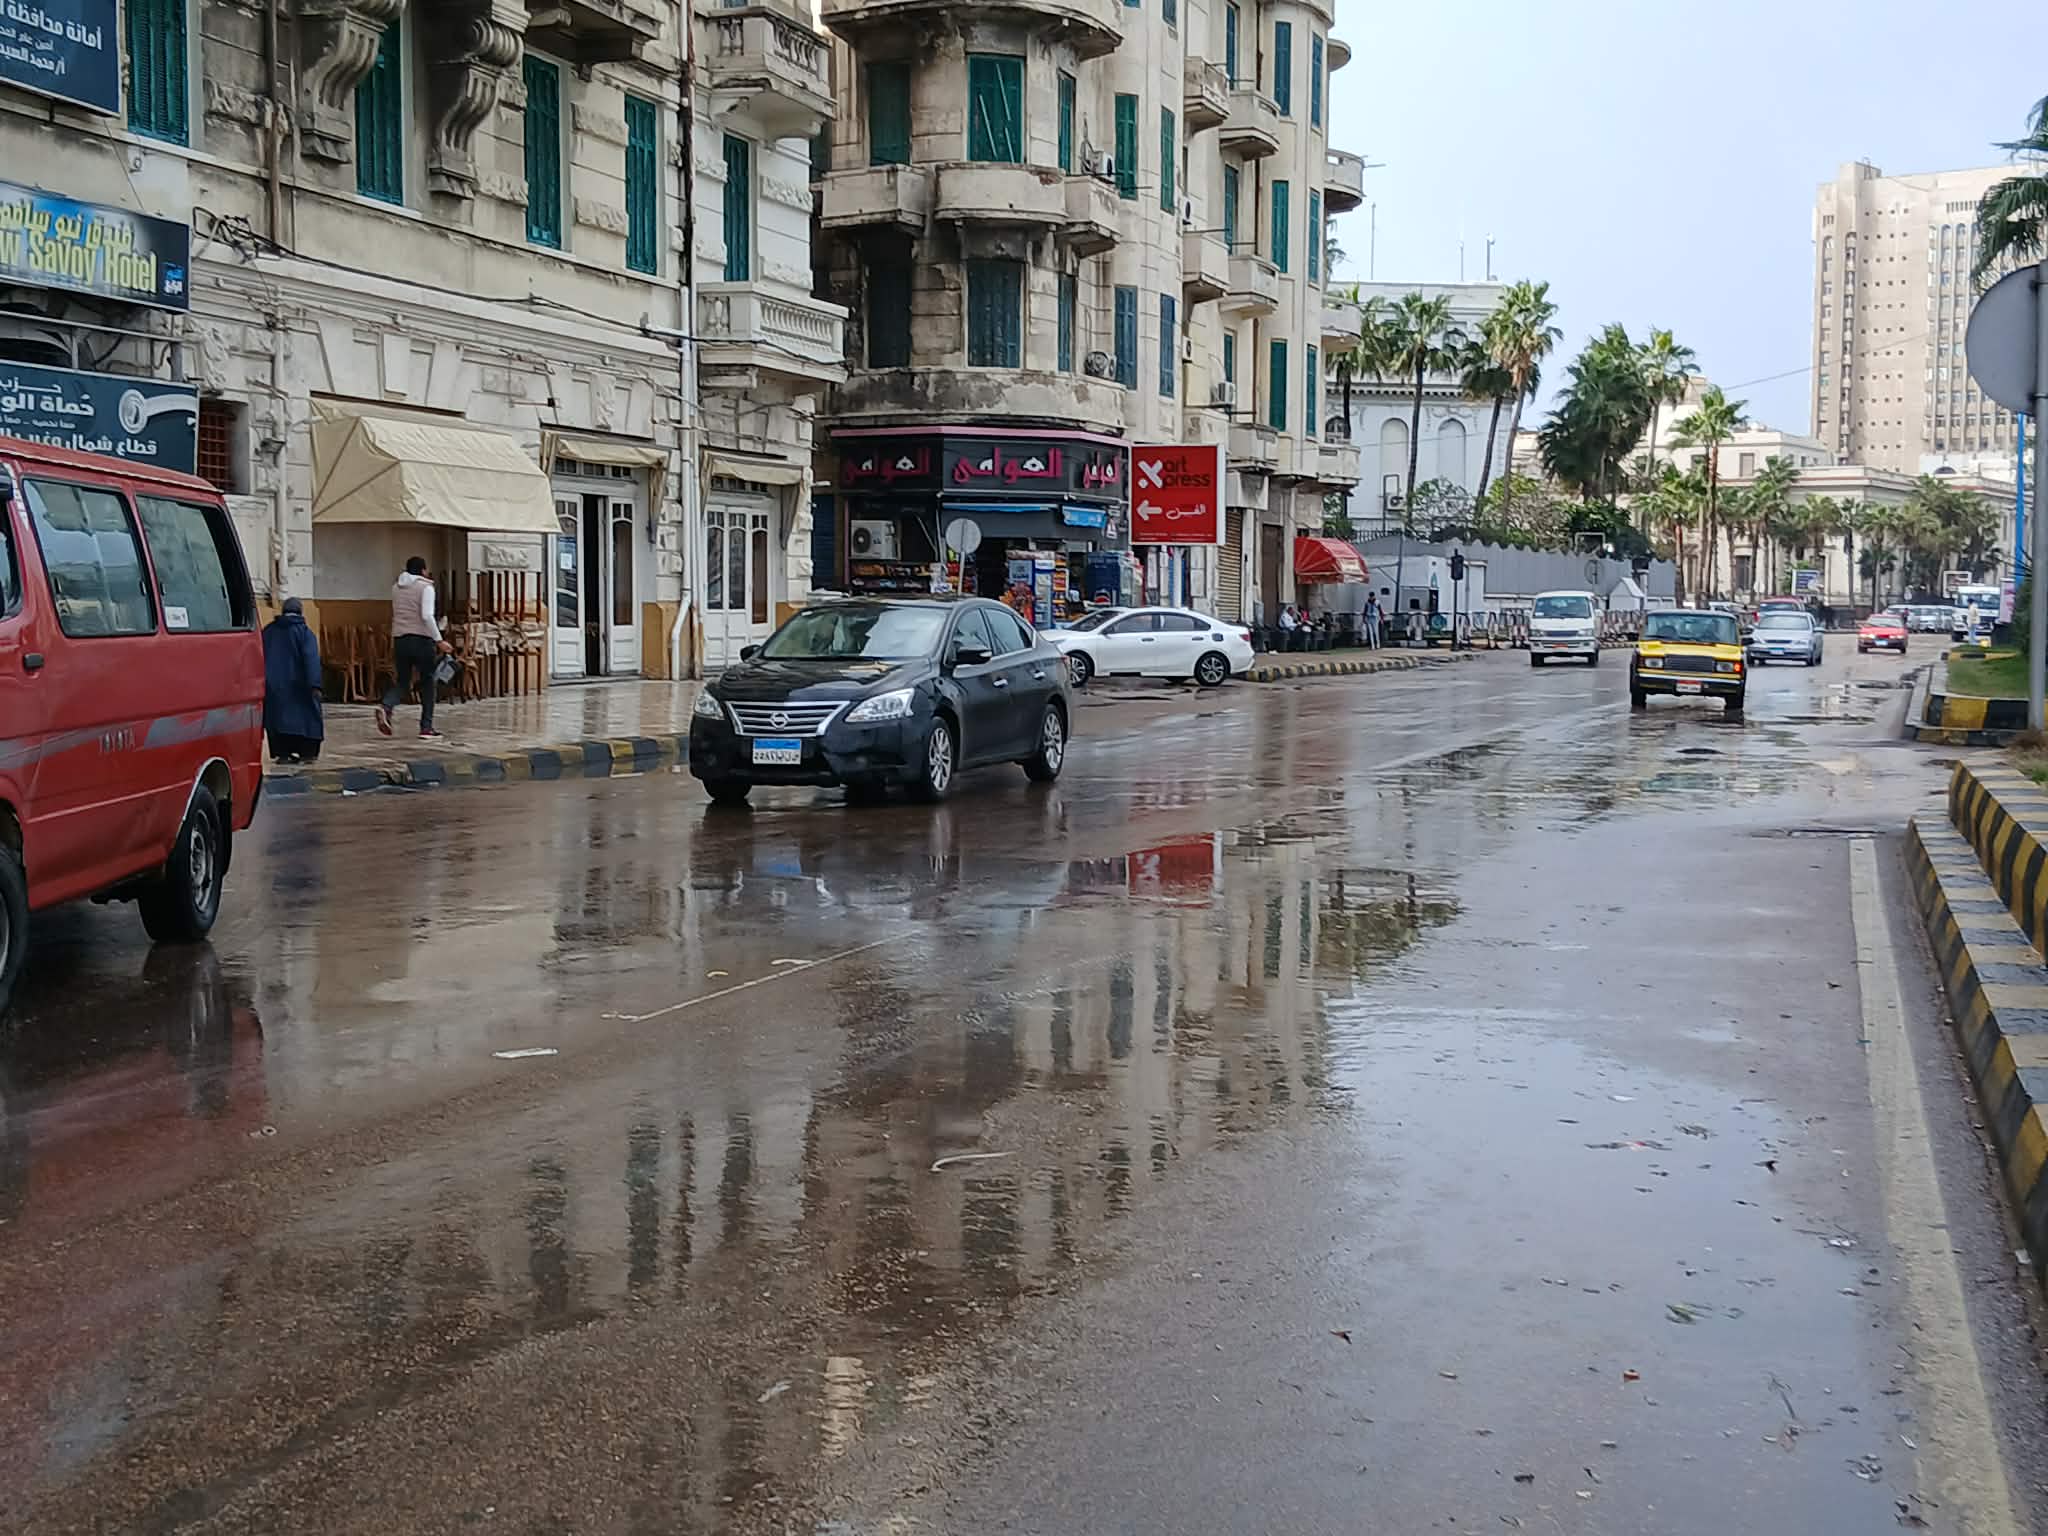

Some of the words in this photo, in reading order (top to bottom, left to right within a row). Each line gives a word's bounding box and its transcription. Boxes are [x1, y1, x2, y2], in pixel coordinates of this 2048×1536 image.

[55, 213, 83, 241] نيو
[86, 217, 134, 254] فندق
[29, 230, 97, 288] Savoy
[104, 243, 157, 294] Hotel
[114, 437, 157, 456] قطاع
